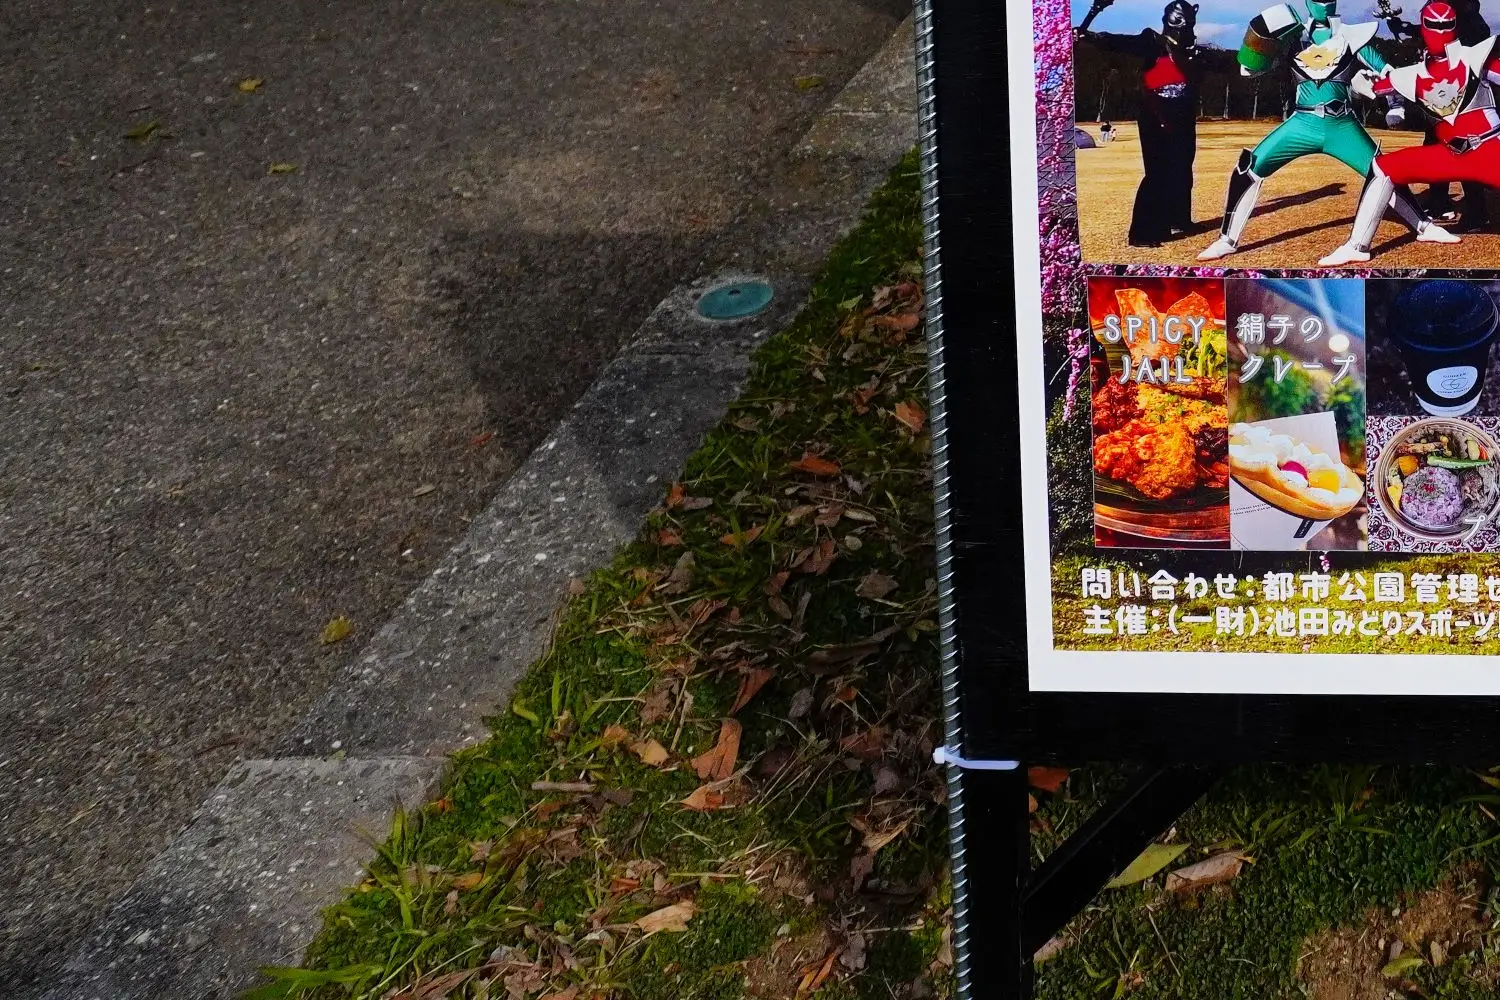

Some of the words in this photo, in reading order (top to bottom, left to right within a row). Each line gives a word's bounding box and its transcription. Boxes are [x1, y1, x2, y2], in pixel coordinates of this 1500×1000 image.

[1102, 313, 1207, 345] SPICY
[1235, 312, 1325, 345] 絹子の
[1117, 353, 1195, 385] JAIL
[1238, 353, 1357, 385] クレープ
